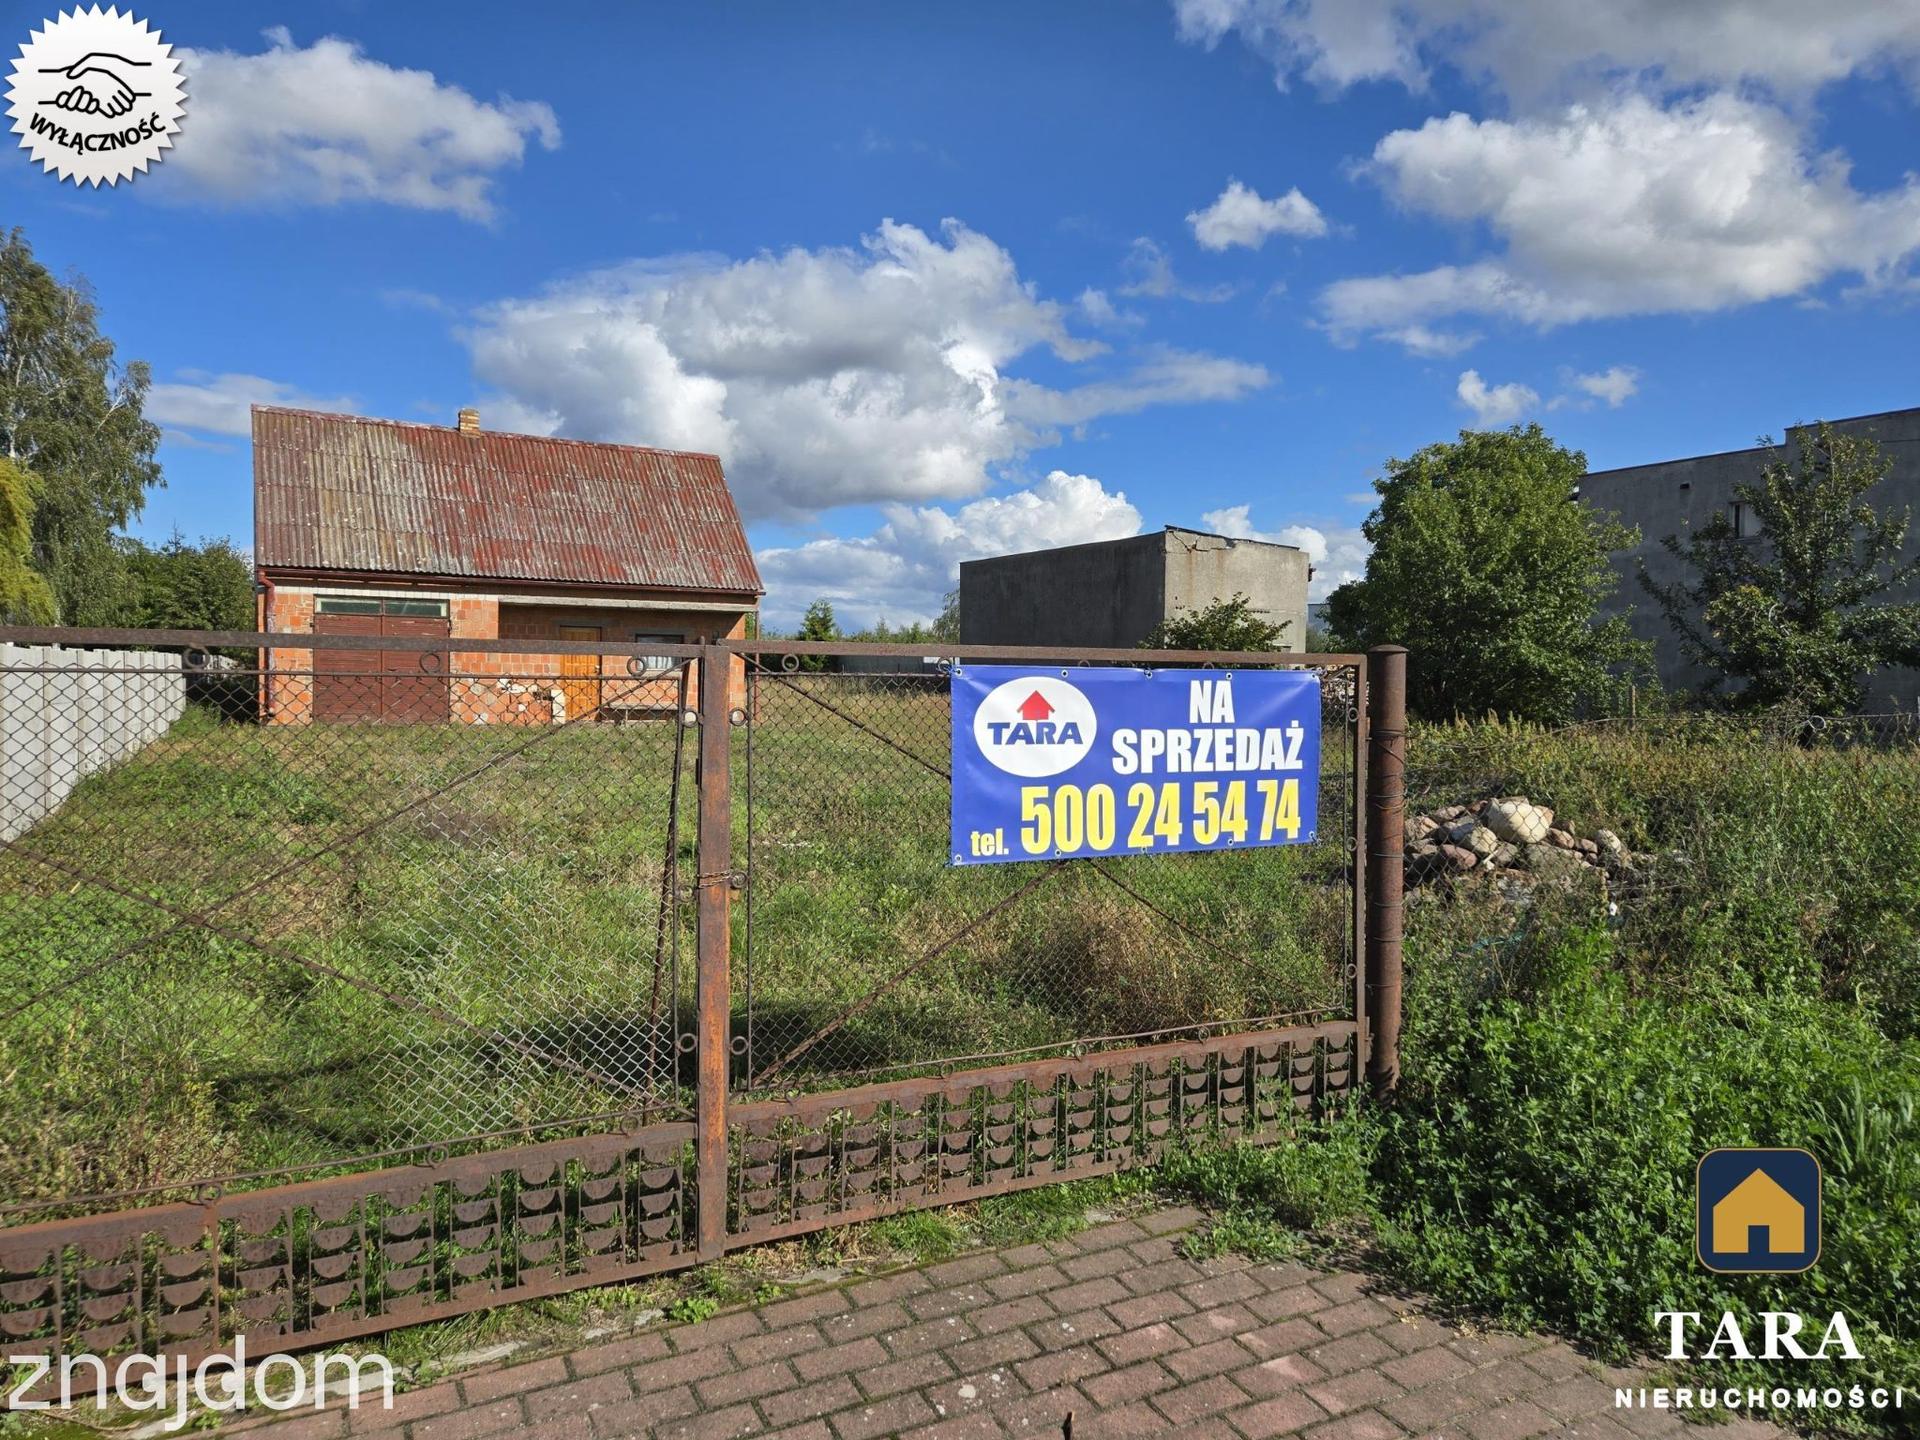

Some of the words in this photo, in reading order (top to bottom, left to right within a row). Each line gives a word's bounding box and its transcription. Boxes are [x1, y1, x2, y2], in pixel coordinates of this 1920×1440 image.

[1189, 679, 1235, 724] NA
[987, 721, 1084, 746] TARA
[1111, 720, 1304, 775] SPRZEDAŻ
[970, 827, 1009, 857] tel.
[1020, 783, 1116, 855] 500
[1127, 782, 1183, 849] 24
[1192, 780, 1248, 846] 54
[1256, 778, 1302, 842] 74
